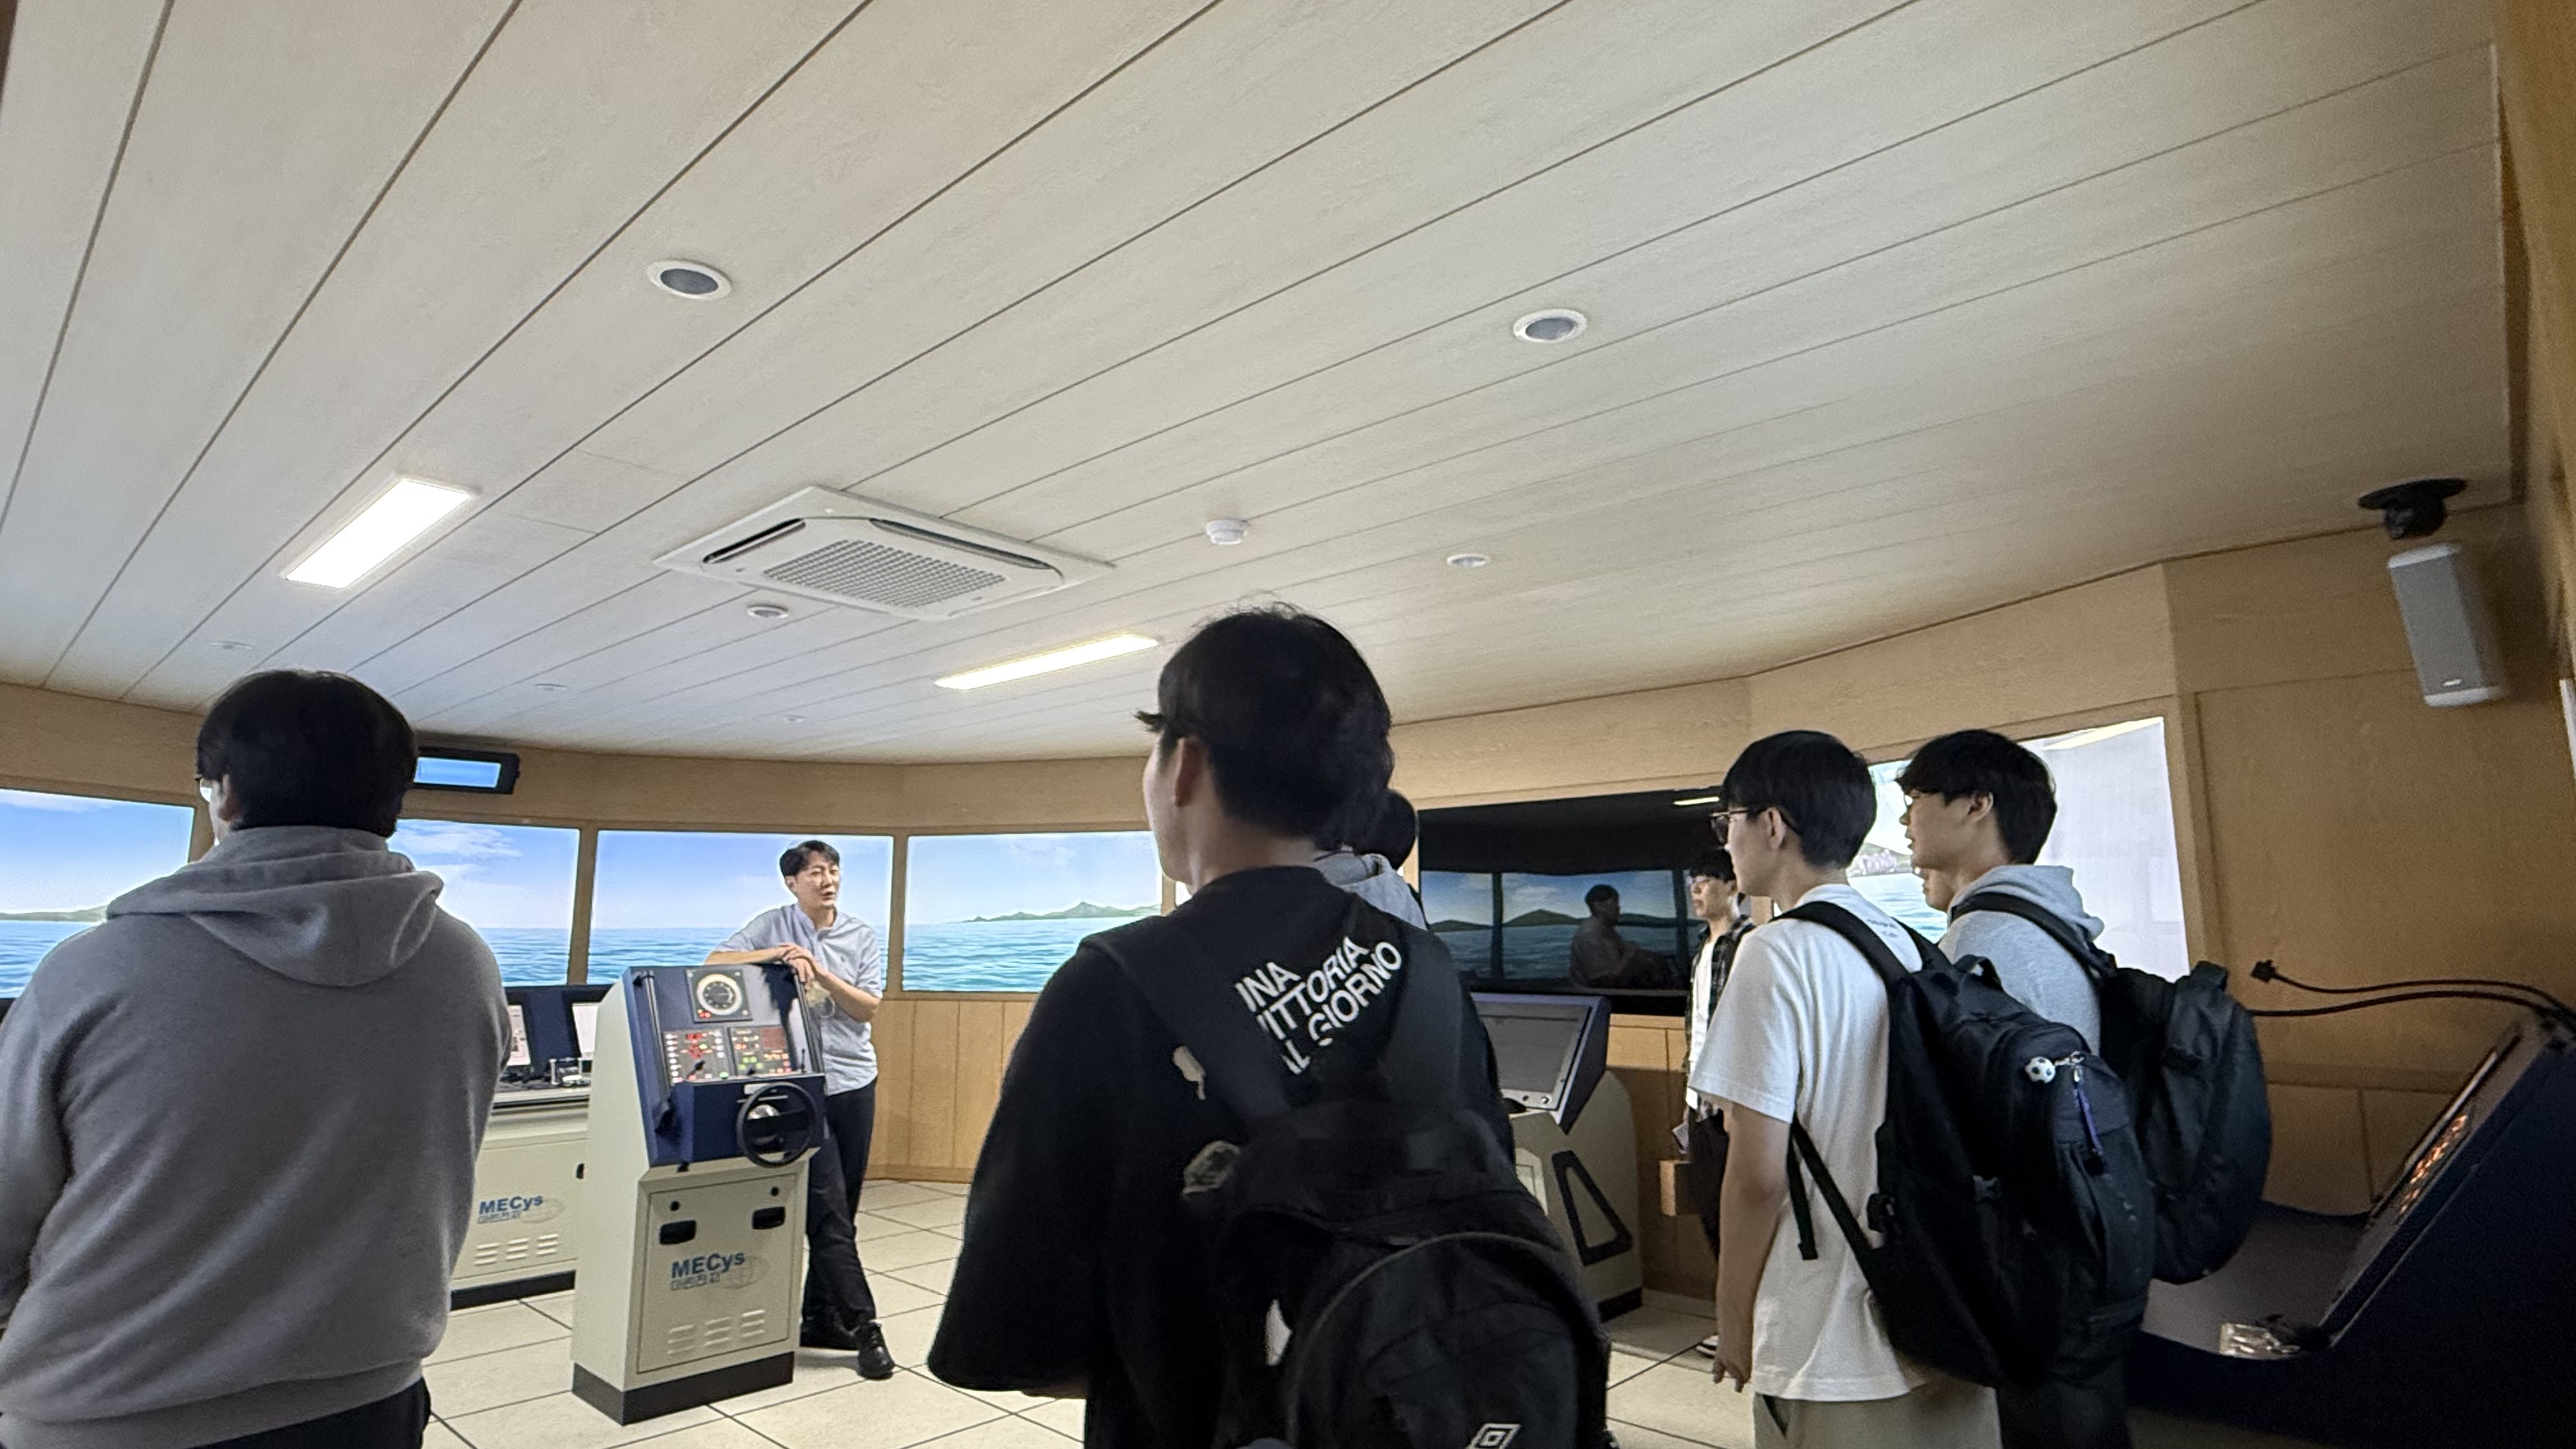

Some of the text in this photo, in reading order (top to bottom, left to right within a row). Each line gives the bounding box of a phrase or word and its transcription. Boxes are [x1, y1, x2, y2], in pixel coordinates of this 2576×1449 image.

[1256, 935, 1370, 1040] ITTORIA
[1308, 942, 1402, 1046] GIORNO
[479, 1195, 543, 1215] MECys
[671, 1252, 746, 1278] MECys
